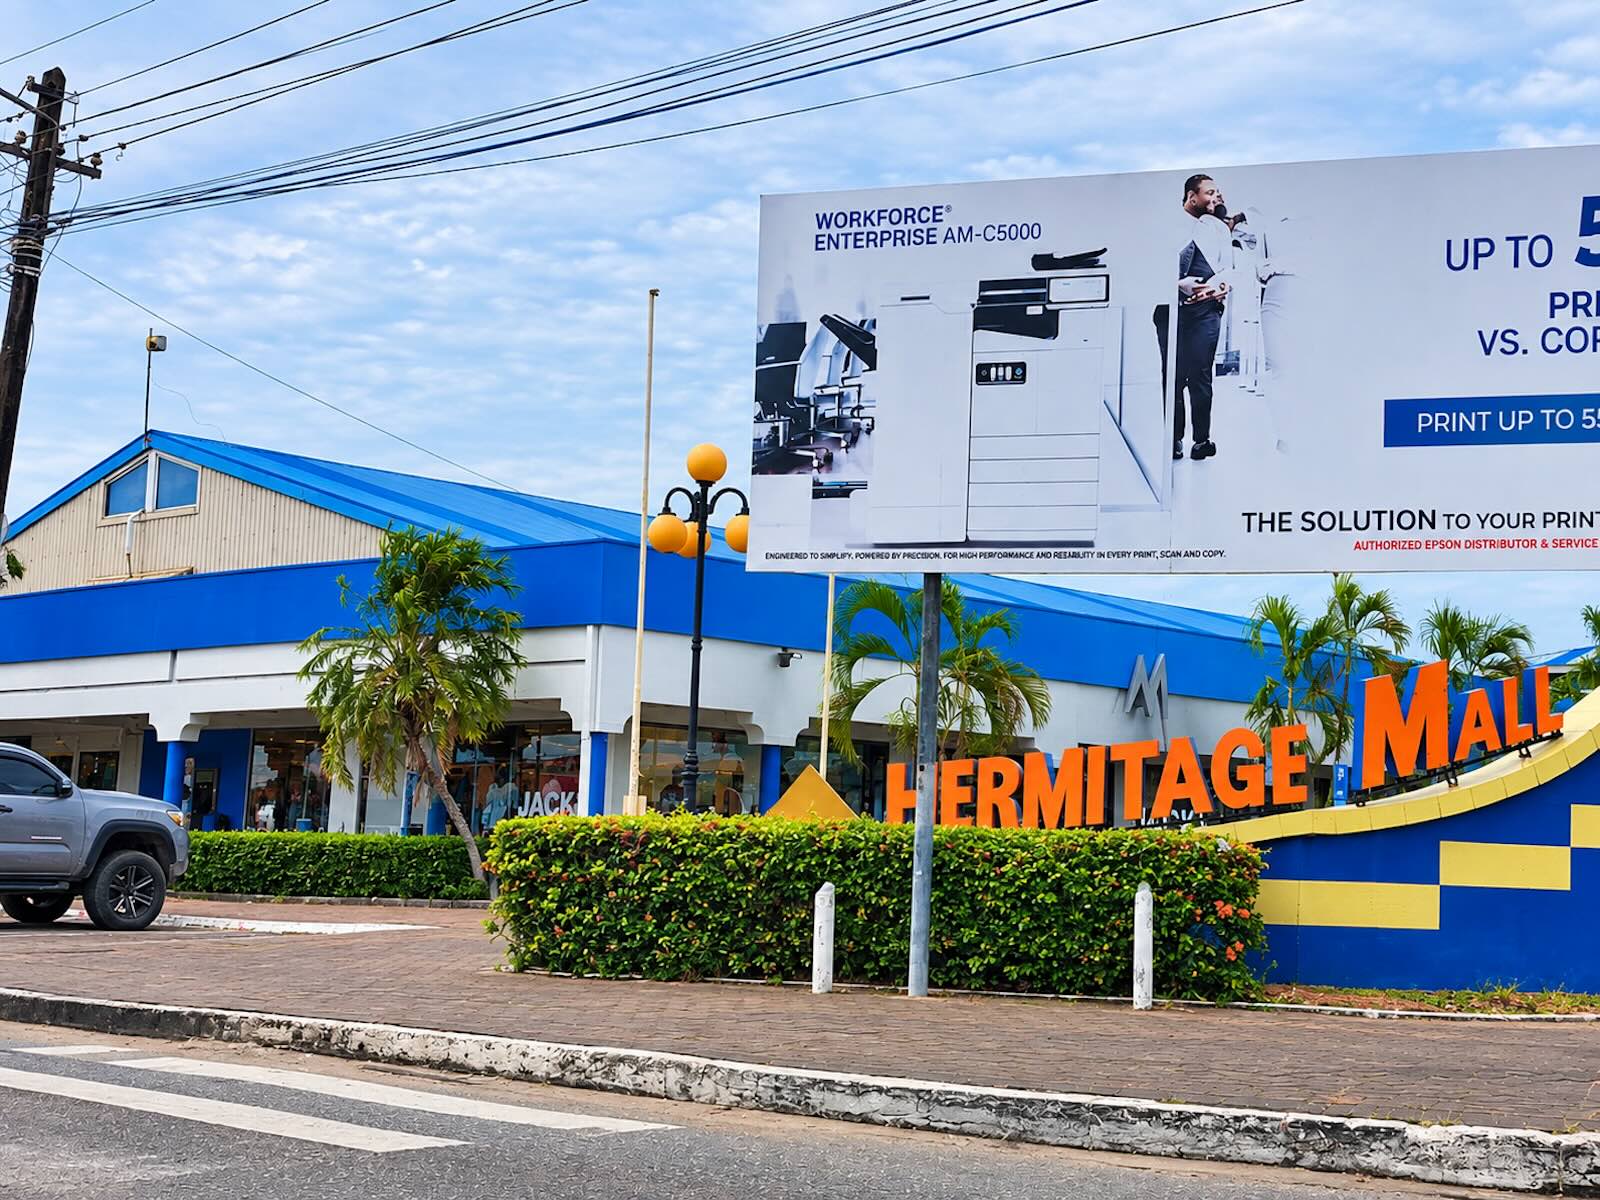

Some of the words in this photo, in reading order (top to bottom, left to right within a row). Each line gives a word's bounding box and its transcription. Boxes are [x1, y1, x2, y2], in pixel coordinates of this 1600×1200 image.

[814, 228, 938, 251] ENTERPRISE
[942, 222, 1042, 244] AM-C5000
[1446, 237, 1496, 272] UP
[1505, 234, 1553, 269] TO
[1477, 329, 1528, 356] VS.
[1417, 411, 1491, 433] PRINT
[1499, 410, 1533, 431] UP
[1540, 408, 1575, 430] TO
[1581, 407, 1600, 430] 5
[1242, 512, 1293, 533] THE
[1300, 509, 1436, 532] SOLUTION
[1443, 513, 1471, 530] TO
[1476, 512, 1536, 530] YOUR
[765, 551, 809, 560] ENGINEERED
[810, 551, 820, 560] TO
[854, 551, 891, 560] POWERED
[891, 551, 902, 560] BY
[943, 550, 959, 560] FOR
[959, 550, 978, 560] HIGH
[979, 550, 1035, 560] PERFORMANCE
[1035, 550, 1053, 560] AND
[1096, 550, 1106, 559] IN
[1106, 550, 1133, 559] EVERY
[1133, 550, 1159, 560] PRINT,
[1159, 549, 1182, 559] SCAN
[1182, 549, 1202, 559] AND
[1202, 549, 1227, 559] COPY.
[1353, 540, 1422, 551] AUTHORIZED
[1425, 539, 1462, 550] EPSON
[1464, 538, 1538, 550] DISTRIBUTOR
[1540, 538, 1549, 549] &
[1551, 538, 1599, 549] SERVICE
[886, 724, 1310, 830] HERMITAGE
[1361, 660, 1565, 791] MALL
[517, 790, 579, 817] JACK
